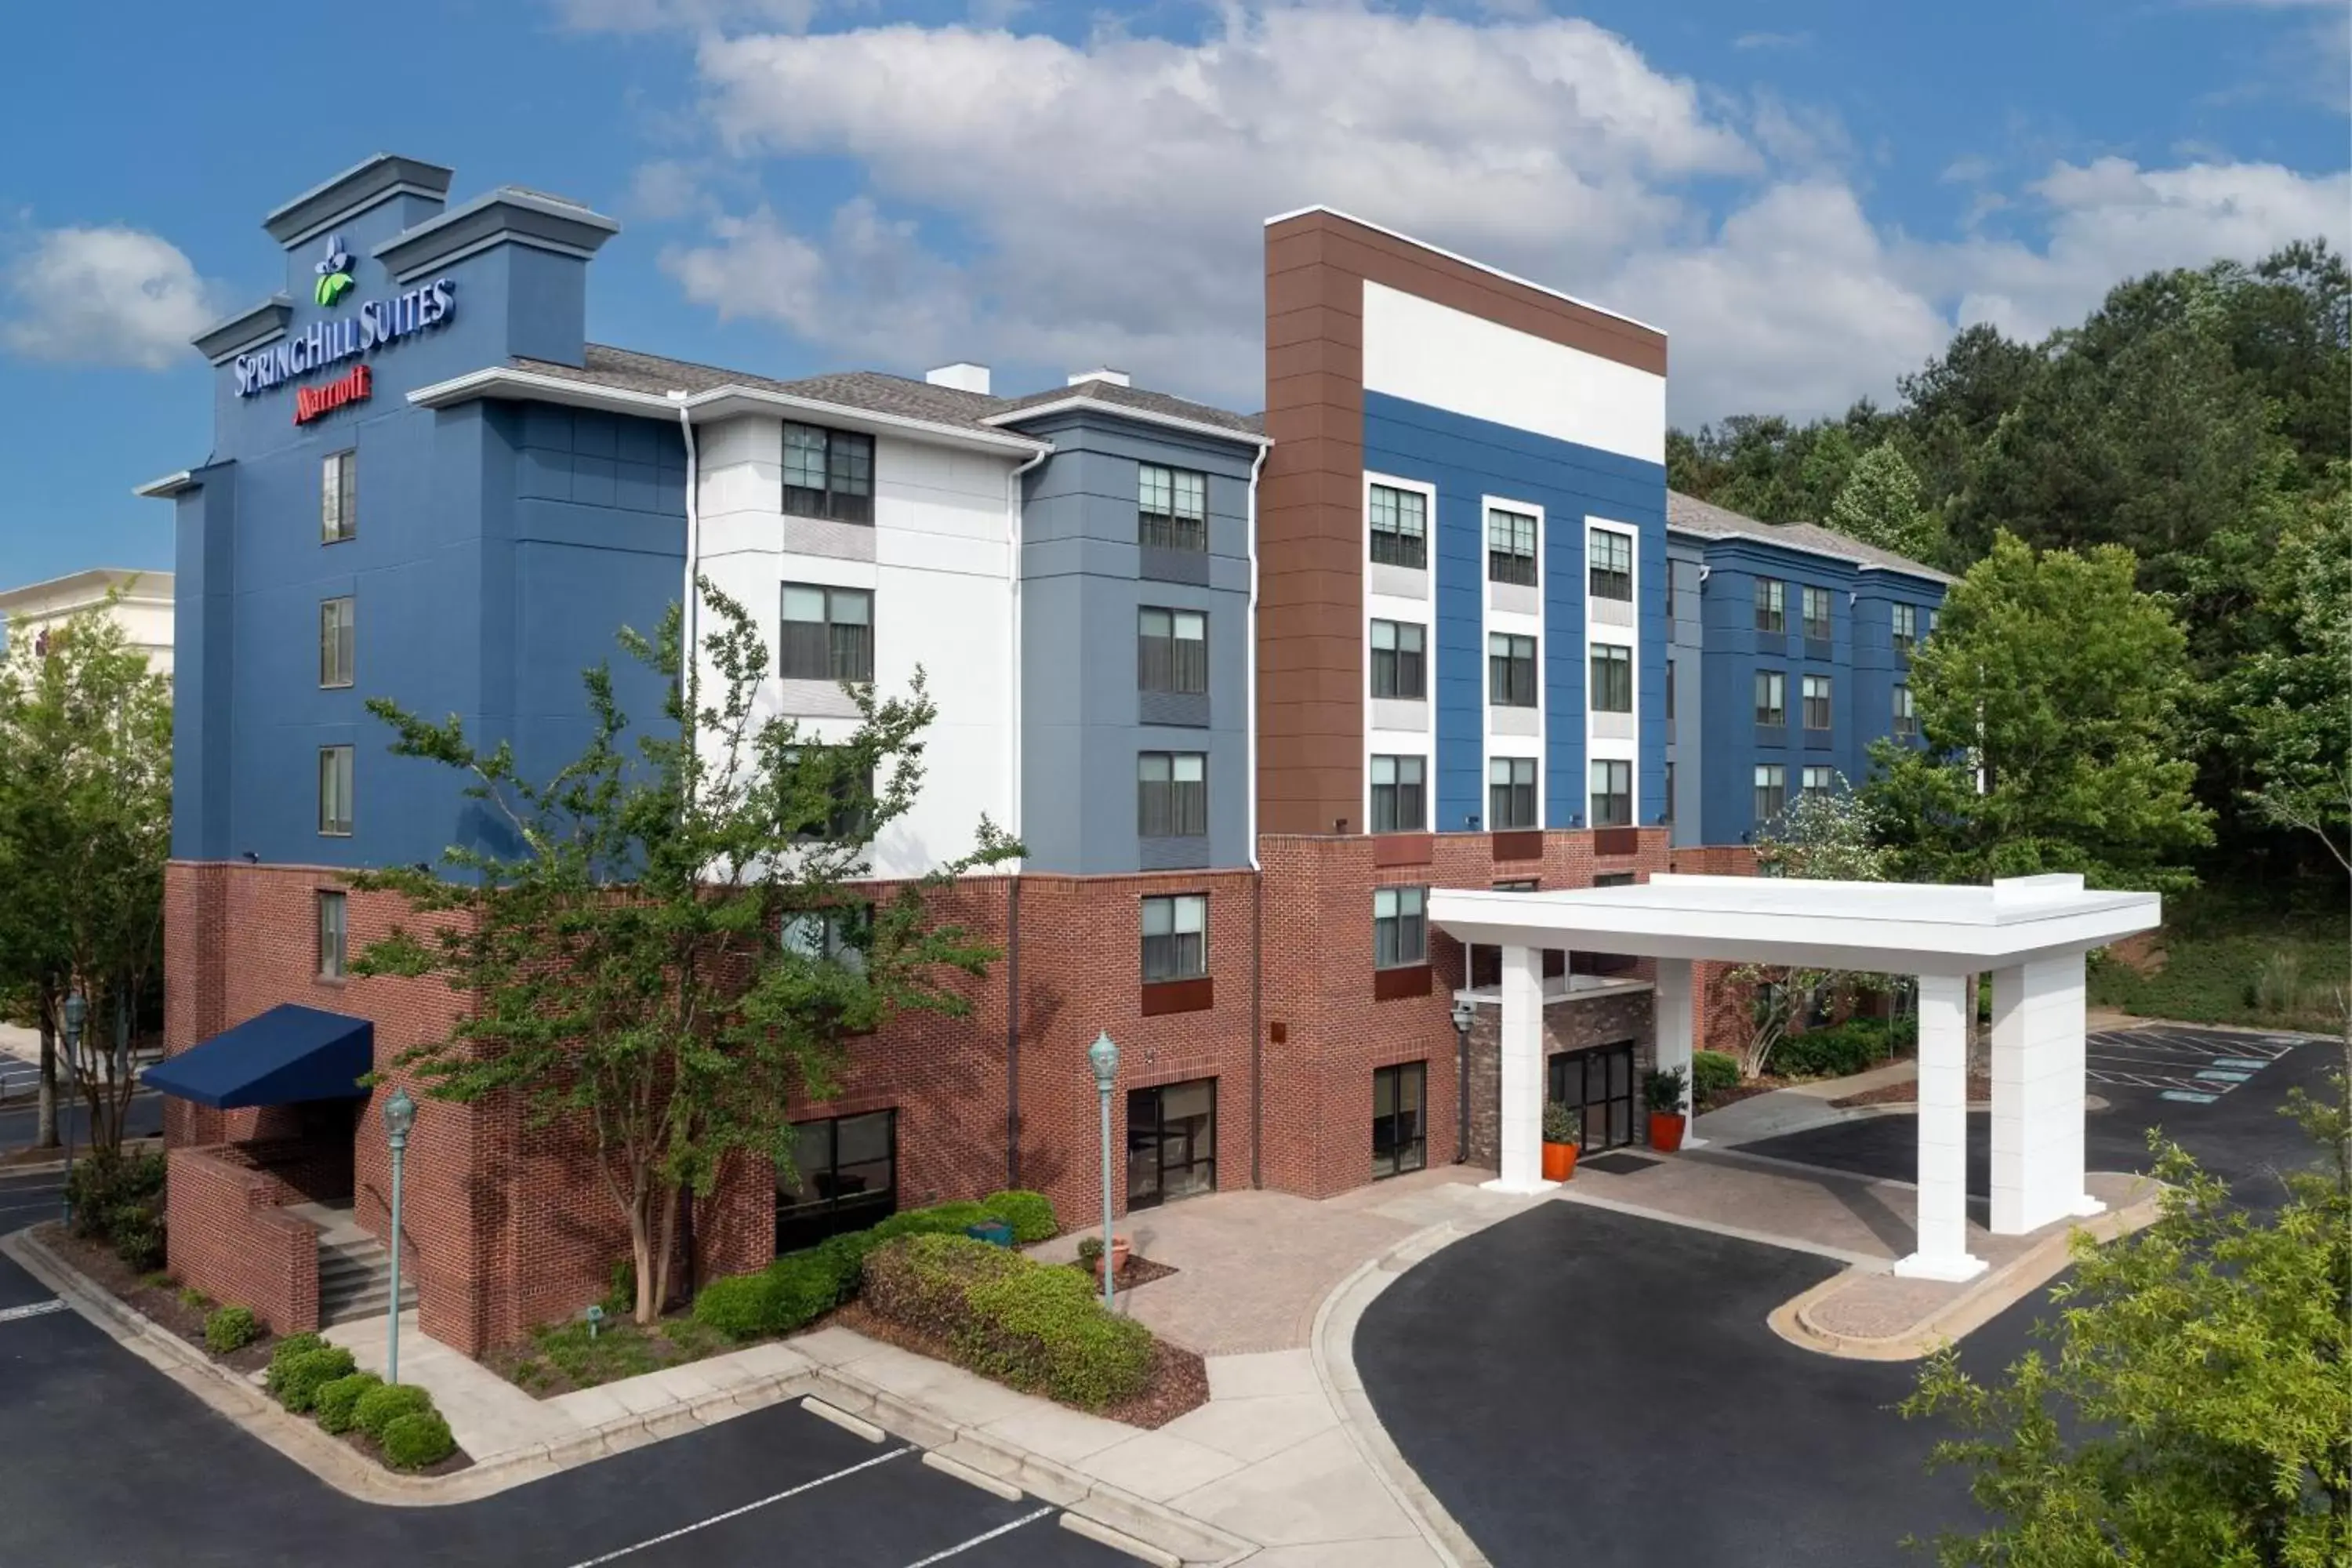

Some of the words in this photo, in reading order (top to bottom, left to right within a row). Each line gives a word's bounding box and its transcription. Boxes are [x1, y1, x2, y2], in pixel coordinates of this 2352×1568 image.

[234, 318, 359, 397] SPRINGHILL
[360, 278, 456, 350] SUITES
[293, 365, 372, 426] Marriott
